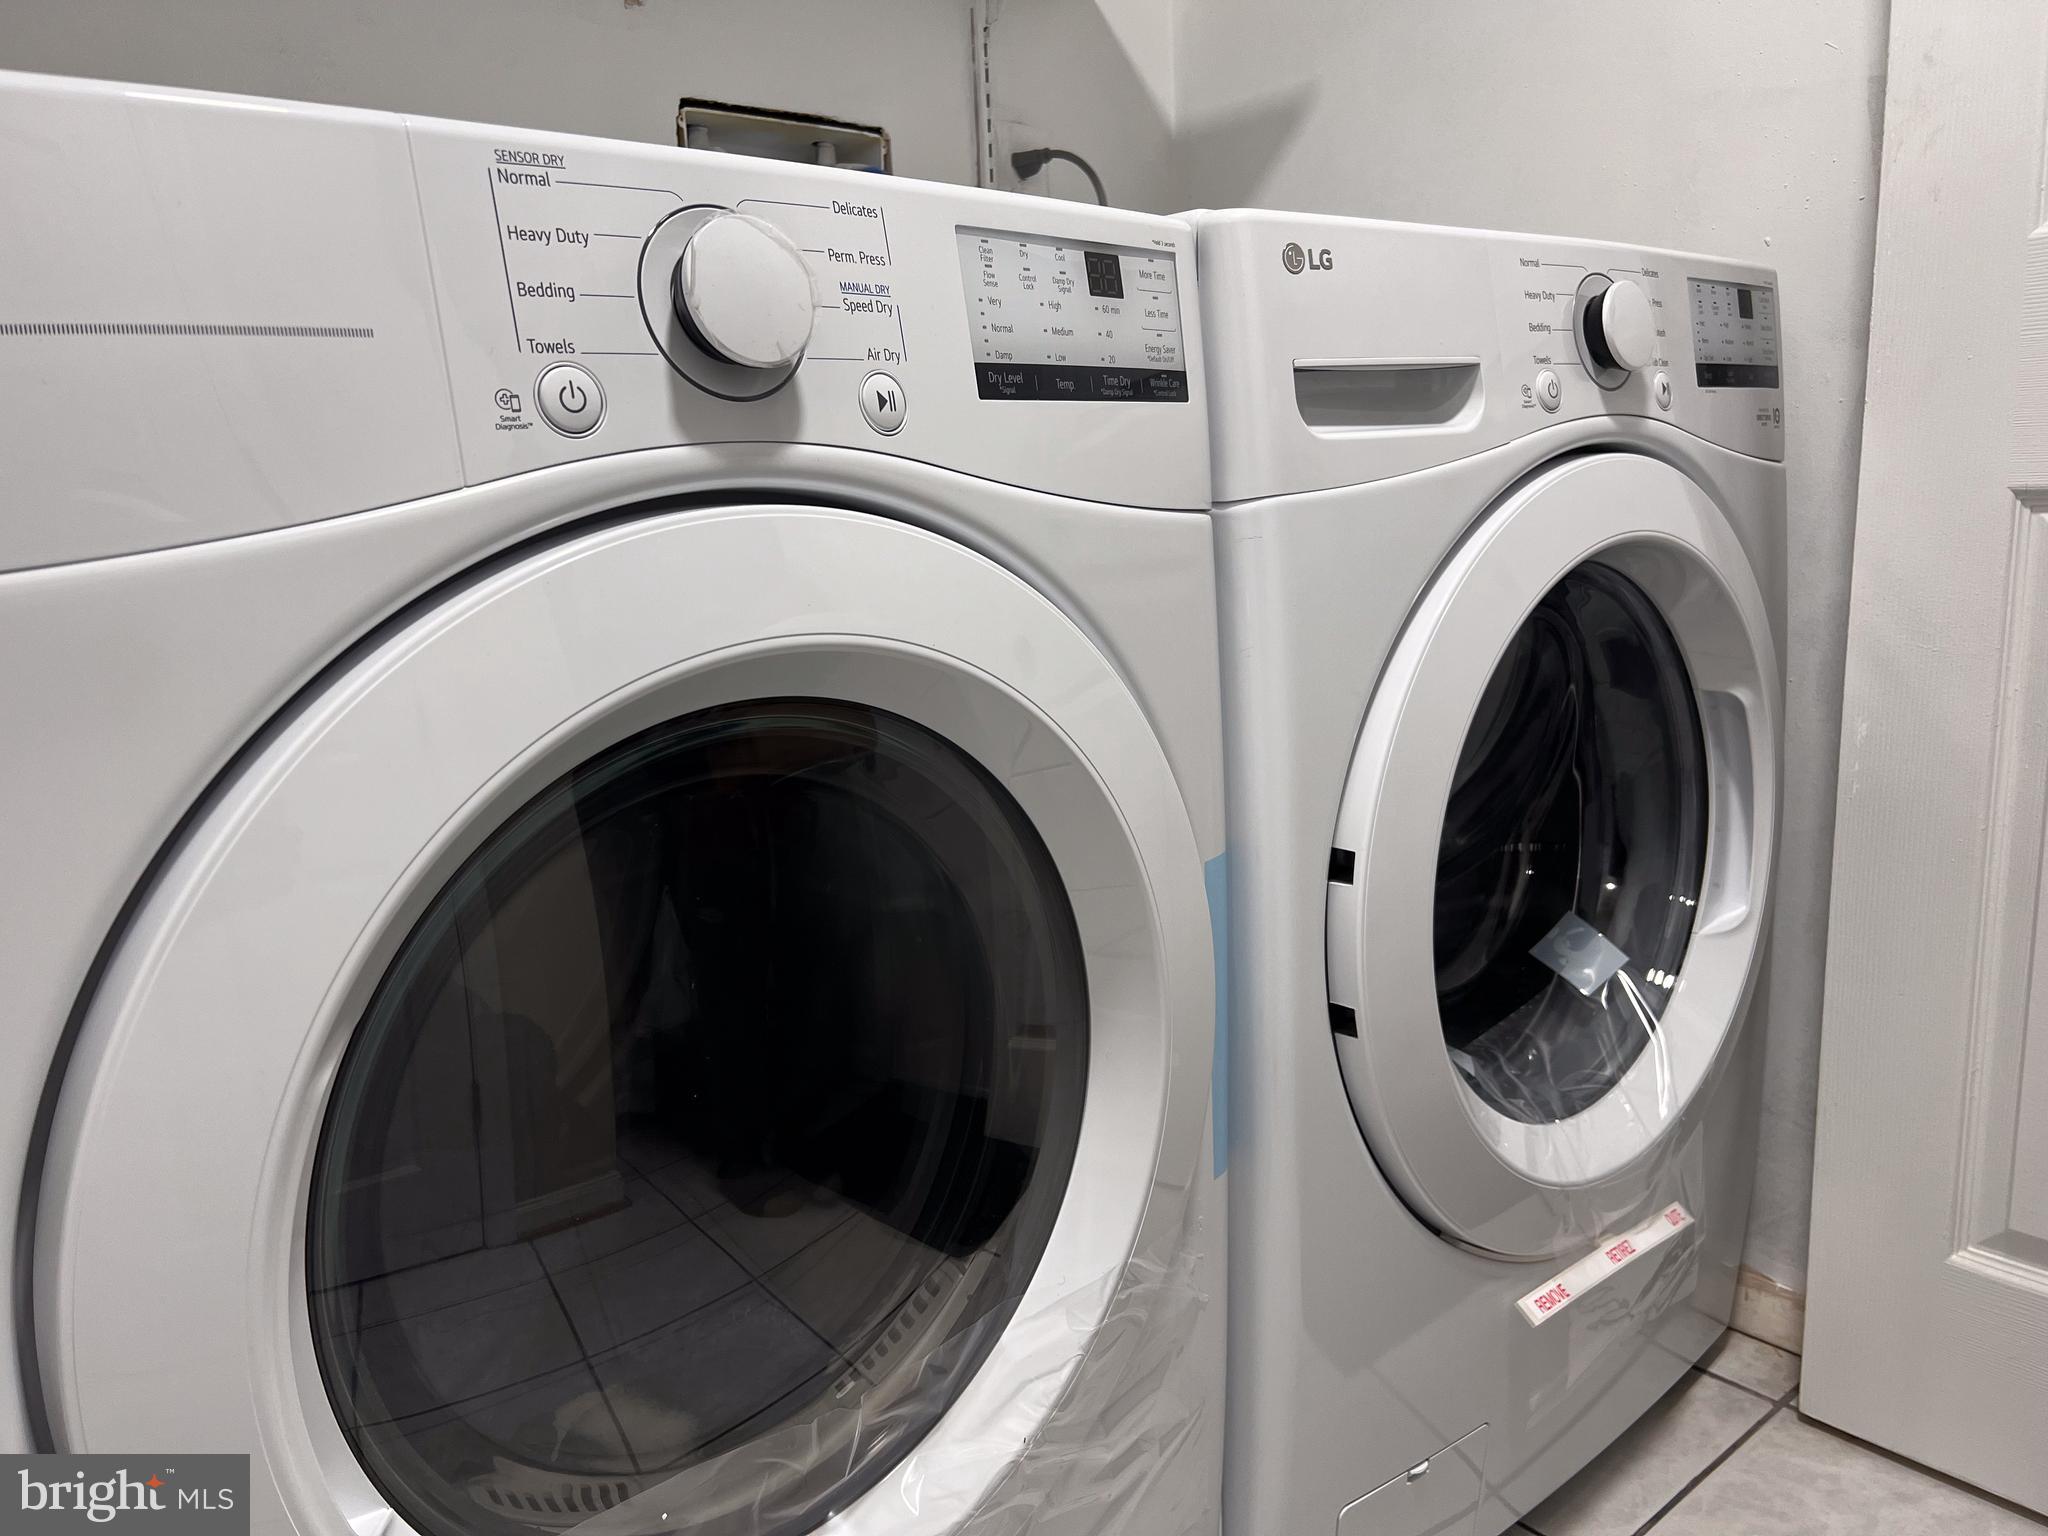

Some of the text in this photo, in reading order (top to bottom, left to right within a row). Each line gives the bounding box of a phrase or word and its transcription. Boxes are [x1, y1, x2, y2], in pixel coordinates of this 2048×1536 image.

[494, 148, 565, 168] SENSOR DRY
[498, 168, 550, 187] Normal
[832, 200, 878, 219] Delicates
[508, 225, 589, 248] Heavy Duty
[979, 246, 993, 255] Clean
[1019, 250, 1028, 260] Dry
[828, 248, 886, 267] Perm. Press
[980, 254, 993, 262] Filter
[1054, 253, 1065, 261] Cool
[1308, 248, 1333, 270] LG
[1520, 258, 1539, 268] Normal
[983, 271, 995, 279] Flow
[1019, 274, 1036, 283] Control
[1139, 270, 1165, 281] More Time
[983, 279, 998, 288] Sense
[1023, 282, 1034, 290] Lock
[1052, 276, 1074, 287] Damp Dry
[518, 281, 575, 302] Bedding
[839, 281, 890, 296] MANUAL DRY
[1058, 285, 1072, 294] Signal
[1525, 290, 1555, 302] Heavy Duty
[988, 297, 1002, 307] Very
[1048, 301, 1061, 310] High
[843, 298, 893, 317] Speed Dry
[1102, 305, 1120, 314] 60 min
[1144, 310, 1168, 319] Less Time
[991, 324, 1014, 333] Normal
[1051, 327, 1073, 336] Medium
[1529, 323, 1551, 334] Bedding
[1106, 330, 1113, 339] 40
[526, 338, 575, 354] Towels
[1145, 344, 1176, 356] Energy Saver
[867, 348, 901, 365] Air Dry
[995, 350, 1012, 360] Damp
[1055, 353, 1066, 362] Low
[1108, 355, 1116, 363] 20
[1533, 356, 1551, 365] Towels
[988, 372, 1023, 385] Dry Level
[1103, 375, 1131, 389] Time Dry
[1168, 379, 1180, 388] Care
[1056, 378, 1075, 390] Temp.
[500, 415, 521, 423] Smart
[1534, 1283, 1570, 1313] REMOVE
[1605, 1239, 1636, 1264] RETIREZ
